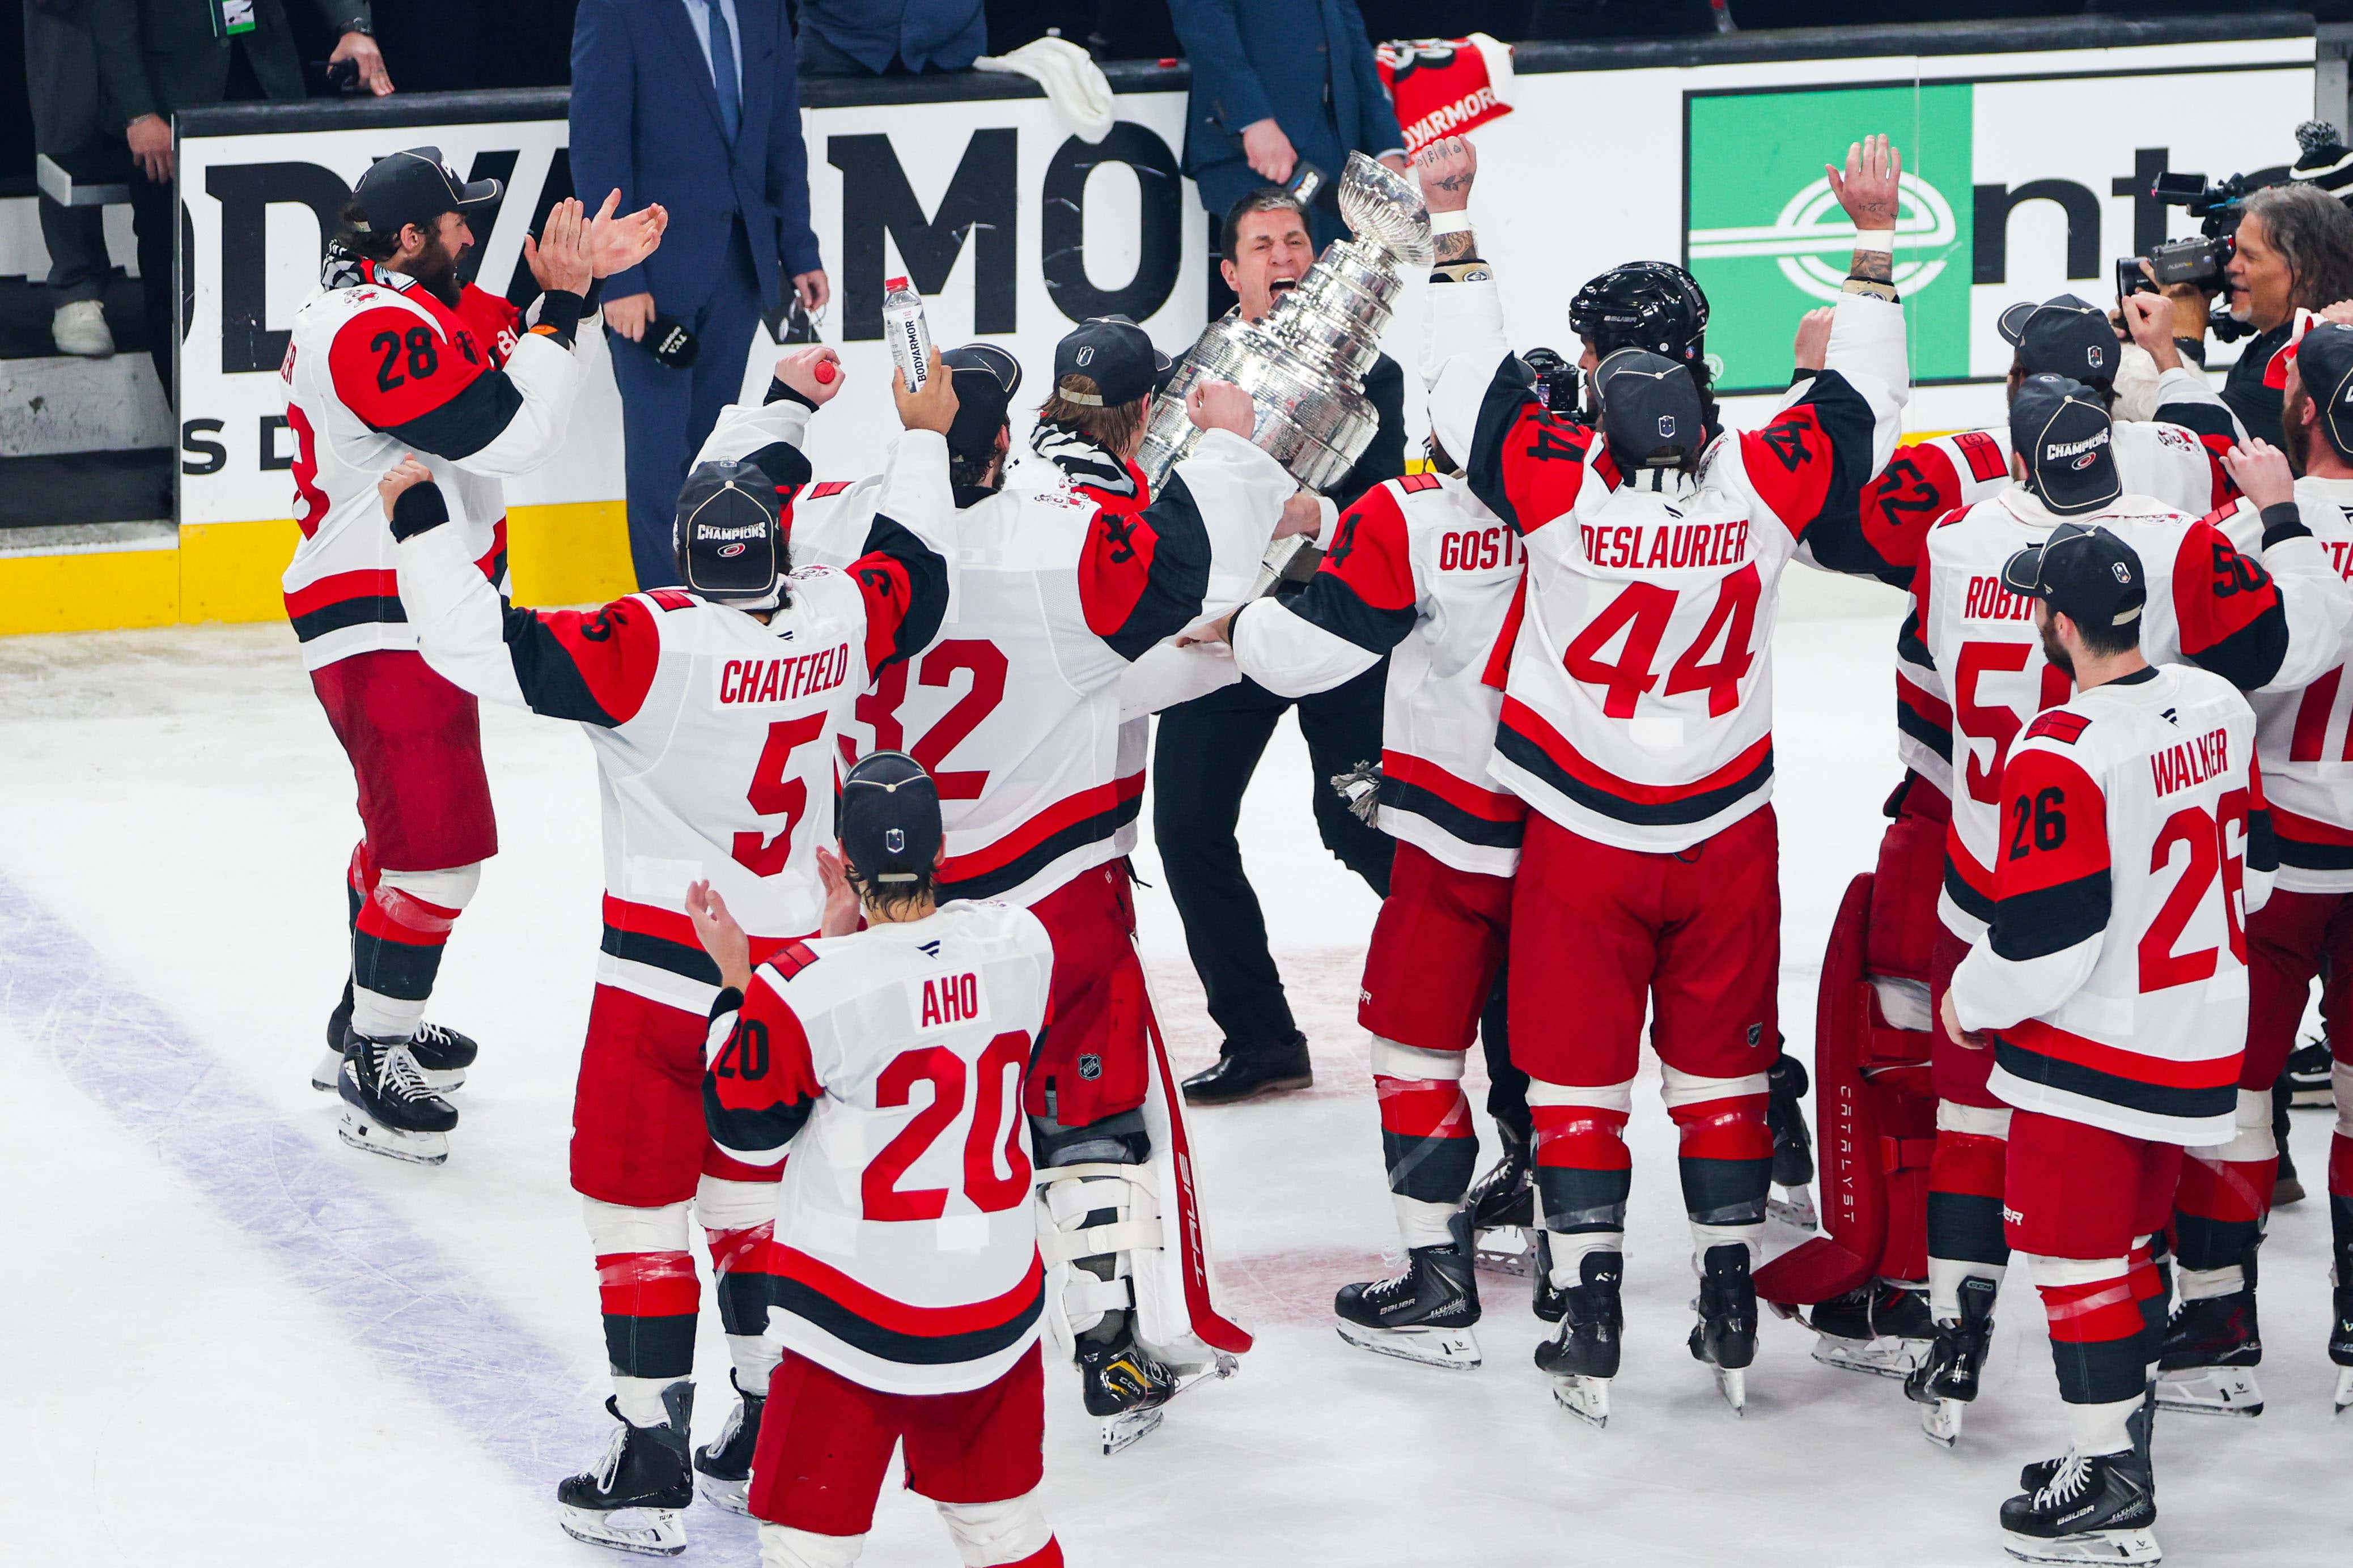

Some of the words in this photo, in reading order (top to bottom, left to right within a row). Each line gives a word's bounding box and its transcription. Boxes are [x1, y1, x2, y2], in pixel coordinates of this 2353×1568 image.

[370, 327, 438, 393] 28
[905, 320, 926, 382] BODYARMOR
[2047, 427, 2109, 461] CHAMPIONS
[1879, 458, 1940, 526] 52
[697, 522, 766, 540] CHAMPIONS
[1329, 513, 1363, 568] 4
[1580, 520, 1749, 568] DESLAURIER
[2212, 544, 2269, 598] 50
[1562, 563, 1761, 719] 44
[719, 642, 849, 704] CHATFIELD
[731, 709, 828, 878] 5
[2150, 728, 2228, 798] WALKER
[2008, 787, 2066, 861] 26
[2138, 788, 2249, 994] 26
[922, 972, 978, 1027] AHO
[717, 1019, 769, 1081] 20
[1083, 1060, 1097, 1075] NHL
[862, 1029, 1032, 1222] 20
[1841, 1086, 1854, 1223] CATALYST
[1178, 1151, 1205, 1288] TRUE
[1379, 1298, 1416, 1315] BAUER
[1119, 1376, 1141, 1395] CCM
[2057, 1505, 2095, 1525] BAUER
